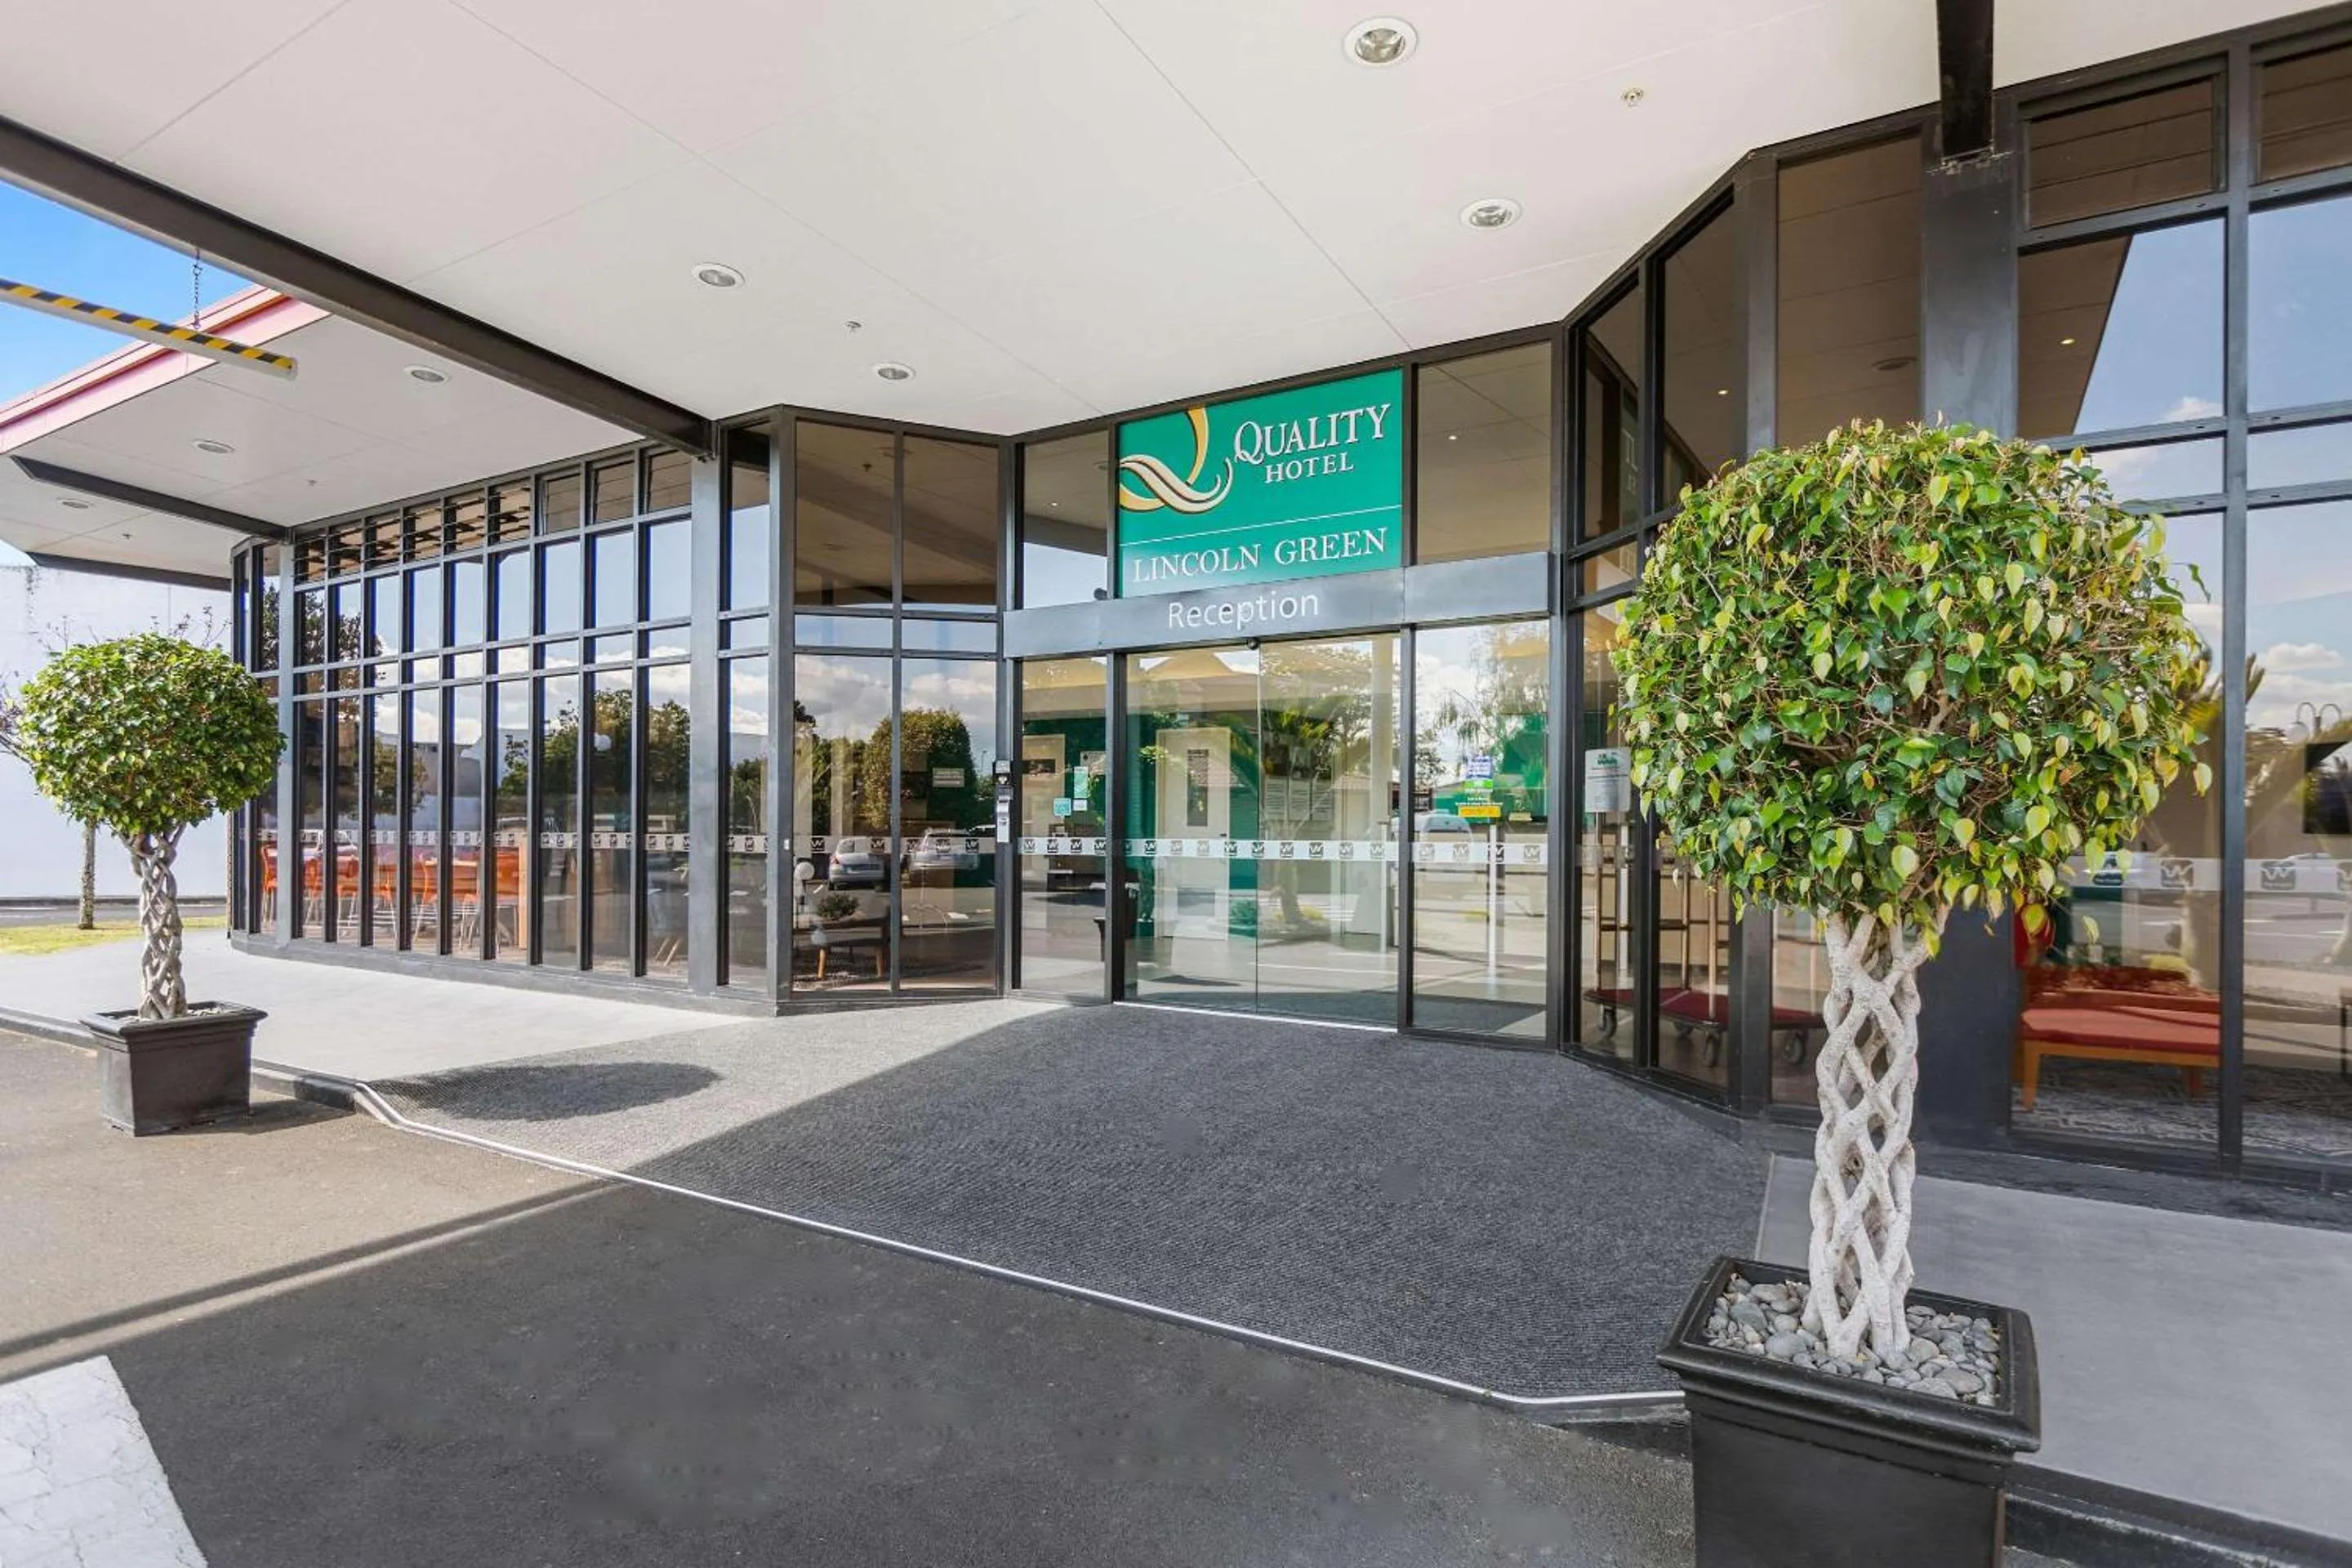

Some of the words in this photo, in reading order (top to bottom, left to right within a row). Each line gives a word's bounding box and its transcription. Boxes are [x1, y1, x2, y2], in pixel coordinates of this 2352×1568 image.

[1234, 403, 1391, 465] QUALITY
[1264, 452, 1354, 483] HOTEL
[1134, 543, 1262, 582] LINCOLN
[1274, 528, 1388, 565] GREEN
[1169, 590, 1319, 630] Reception
